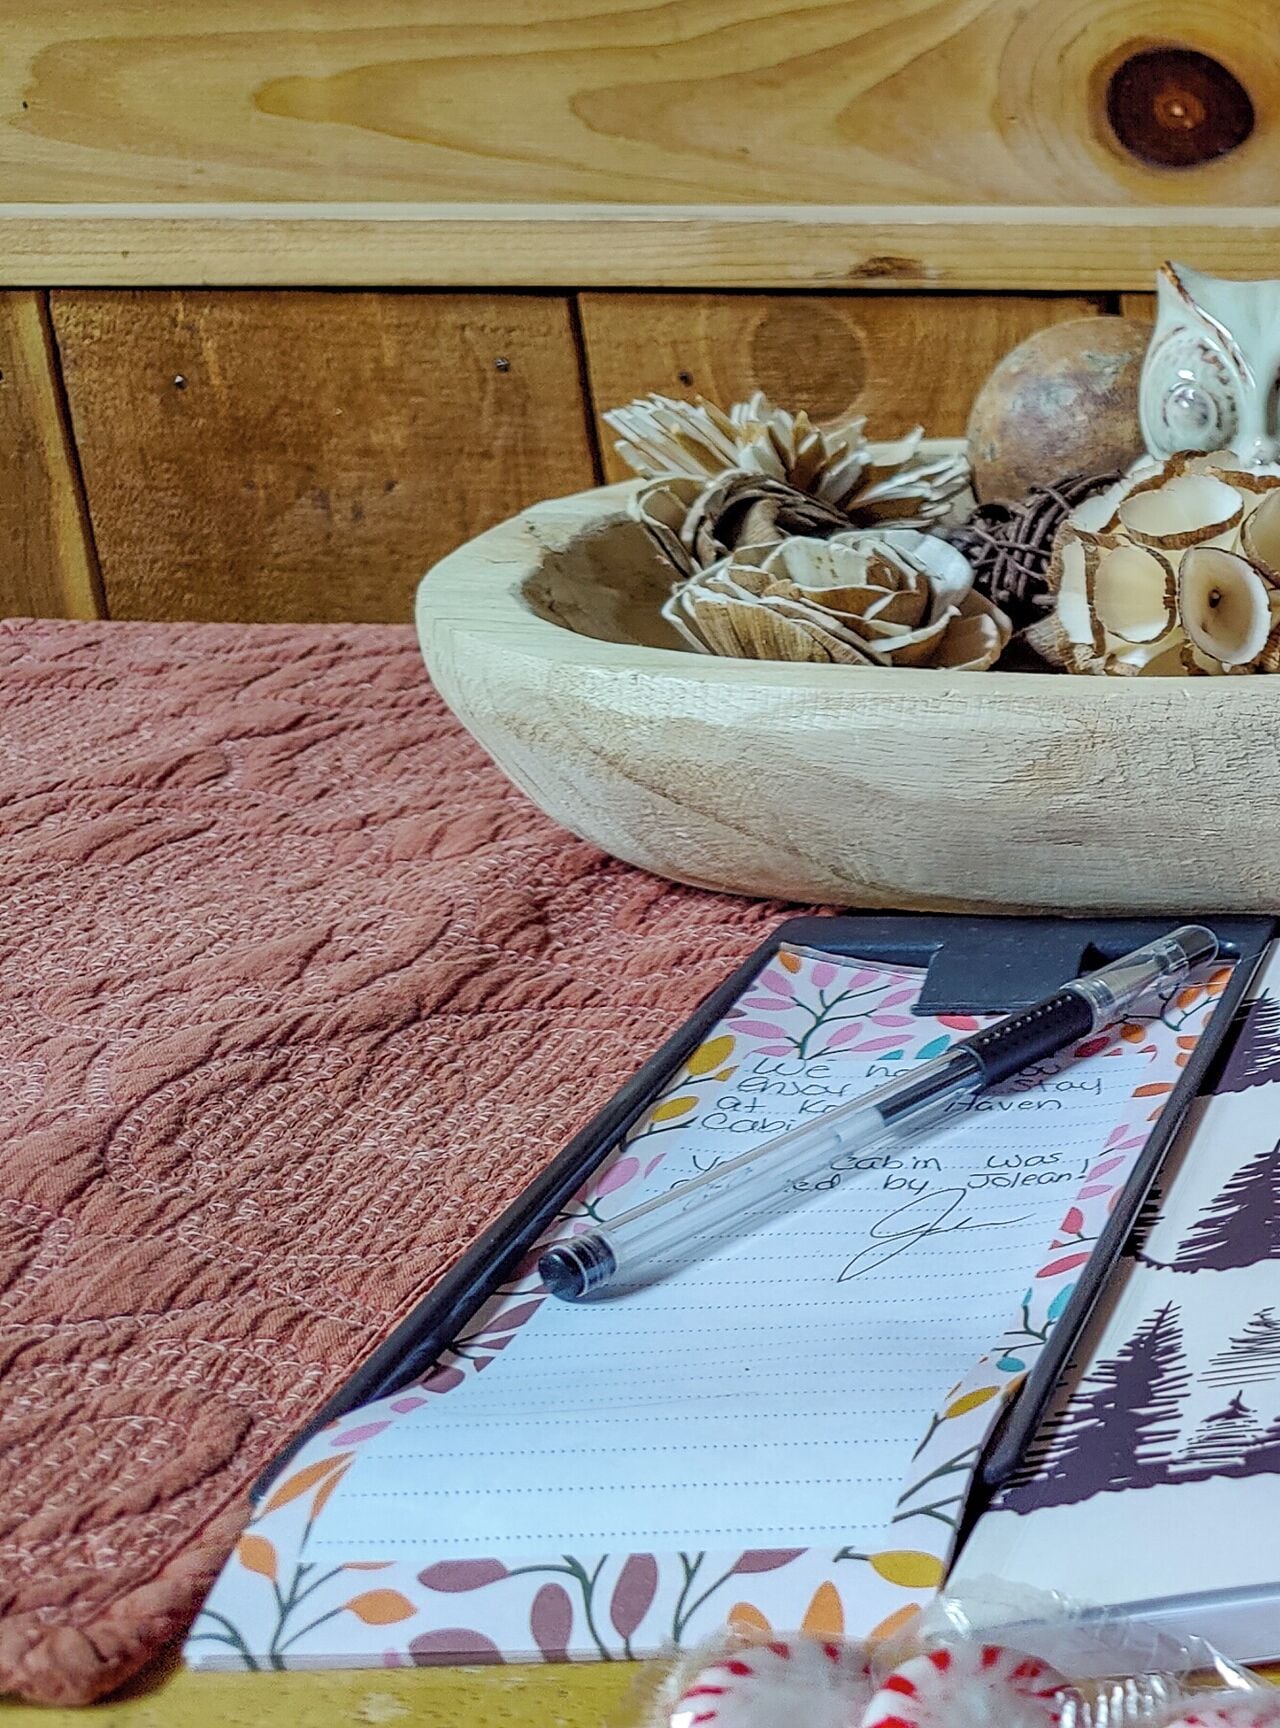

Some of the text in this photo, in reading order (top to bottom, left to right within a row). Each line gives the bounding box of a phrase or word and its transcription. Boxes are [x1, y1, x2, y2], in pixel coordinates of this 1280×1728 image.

[752, 1056, 832, 1079] We
[701, 1112, 797, 1133] Cabi
[882, 1173, 930, 1195] by
